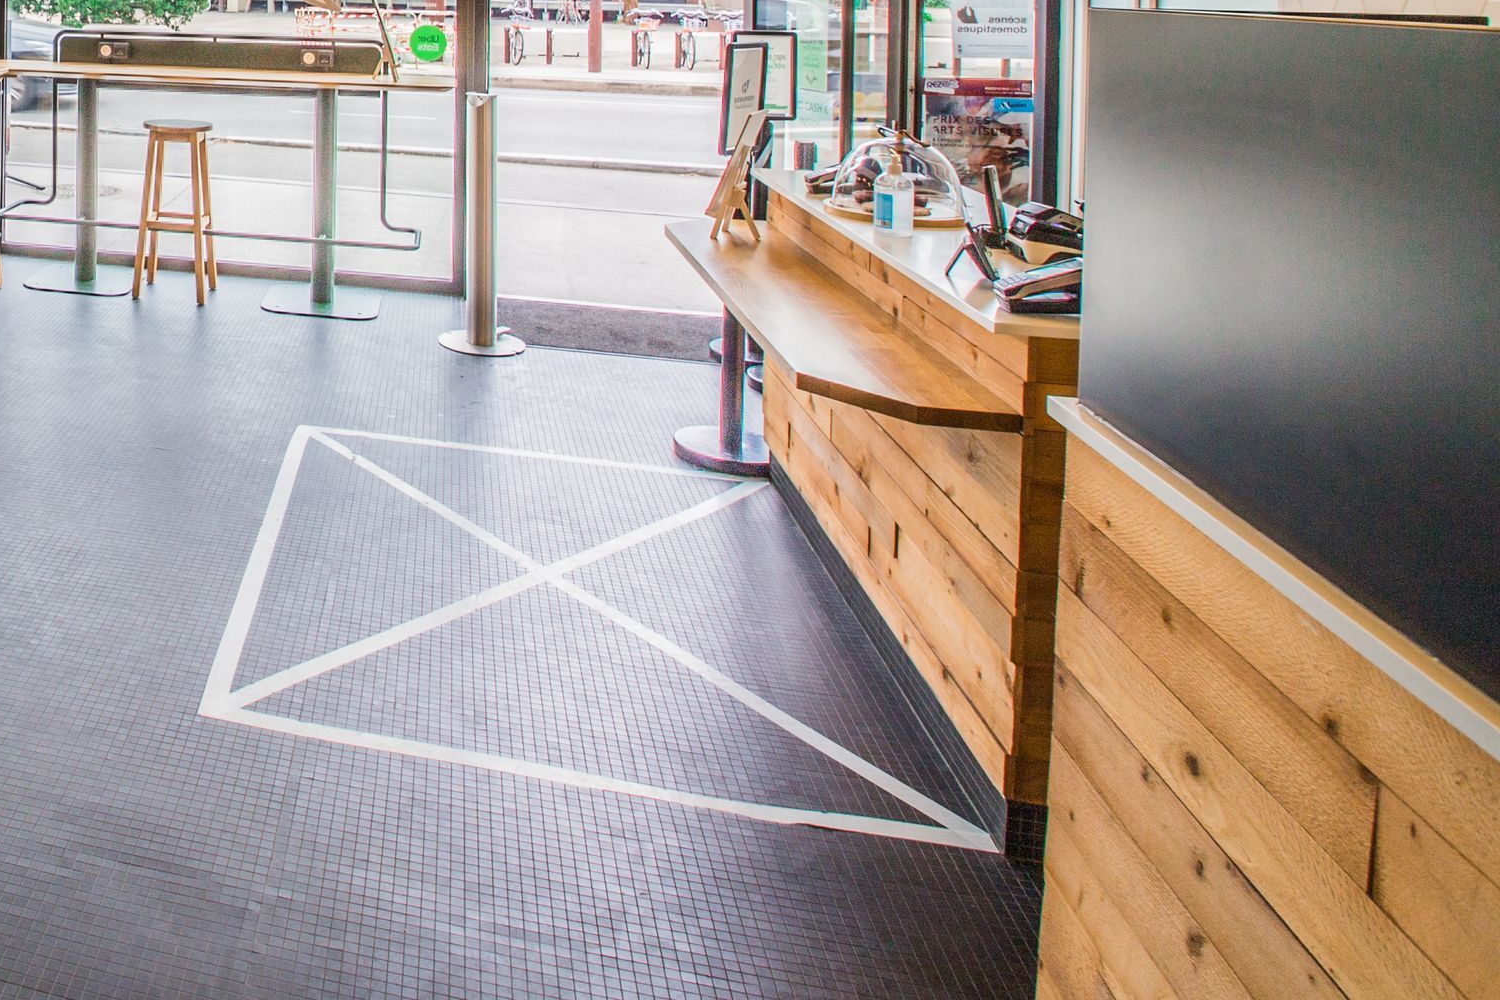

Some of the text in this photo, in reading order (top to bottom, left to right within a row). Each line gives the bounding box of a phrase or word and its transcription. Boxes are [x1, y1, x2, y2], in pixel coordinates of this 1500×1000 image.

[933, 115, 991, 124] PRIX DES
[932, 126, 1023, 136] ARTS VISUELS
